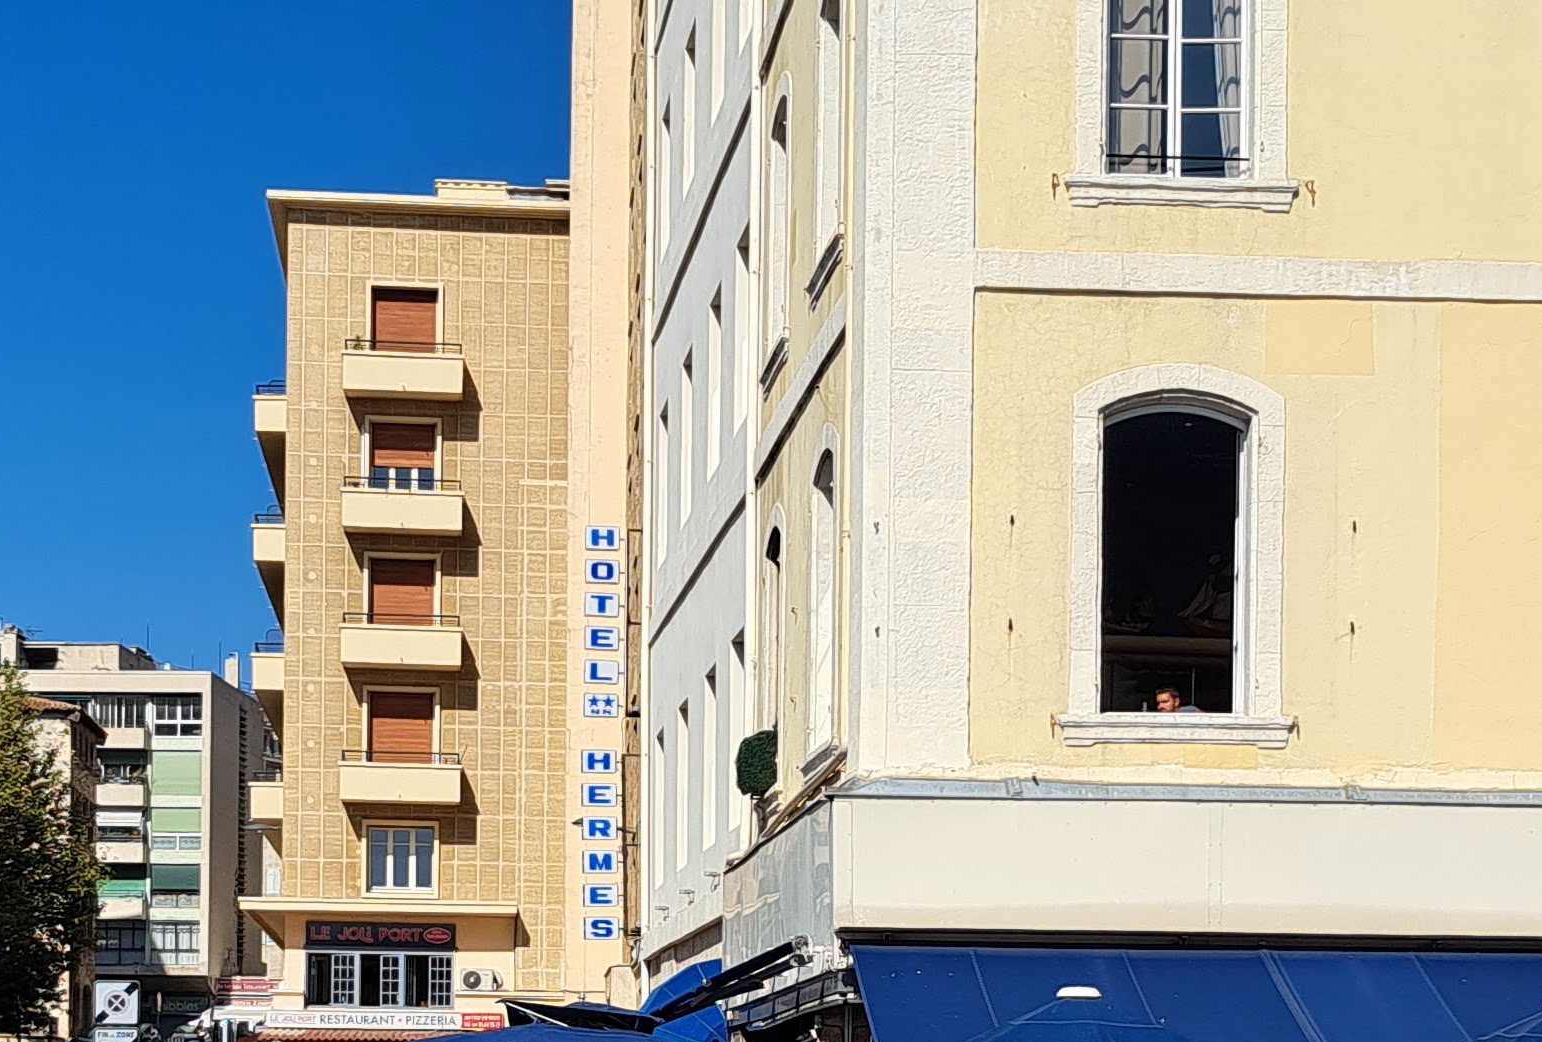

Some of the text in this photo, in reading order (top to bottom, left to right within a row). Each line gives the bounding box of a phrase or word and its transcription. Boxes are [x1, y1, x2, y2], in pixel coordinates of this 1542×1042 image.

[590, 529, 614, 681] HOTEL
[587, 753, 614, 937] HERMES
[310, 925, 332, 941] LE
[378, 926, 424, 943] PORT
[319, 1013, 396, 1027] RESTAURANT
[405, 1015, 458, 1027] PIZZERIA
